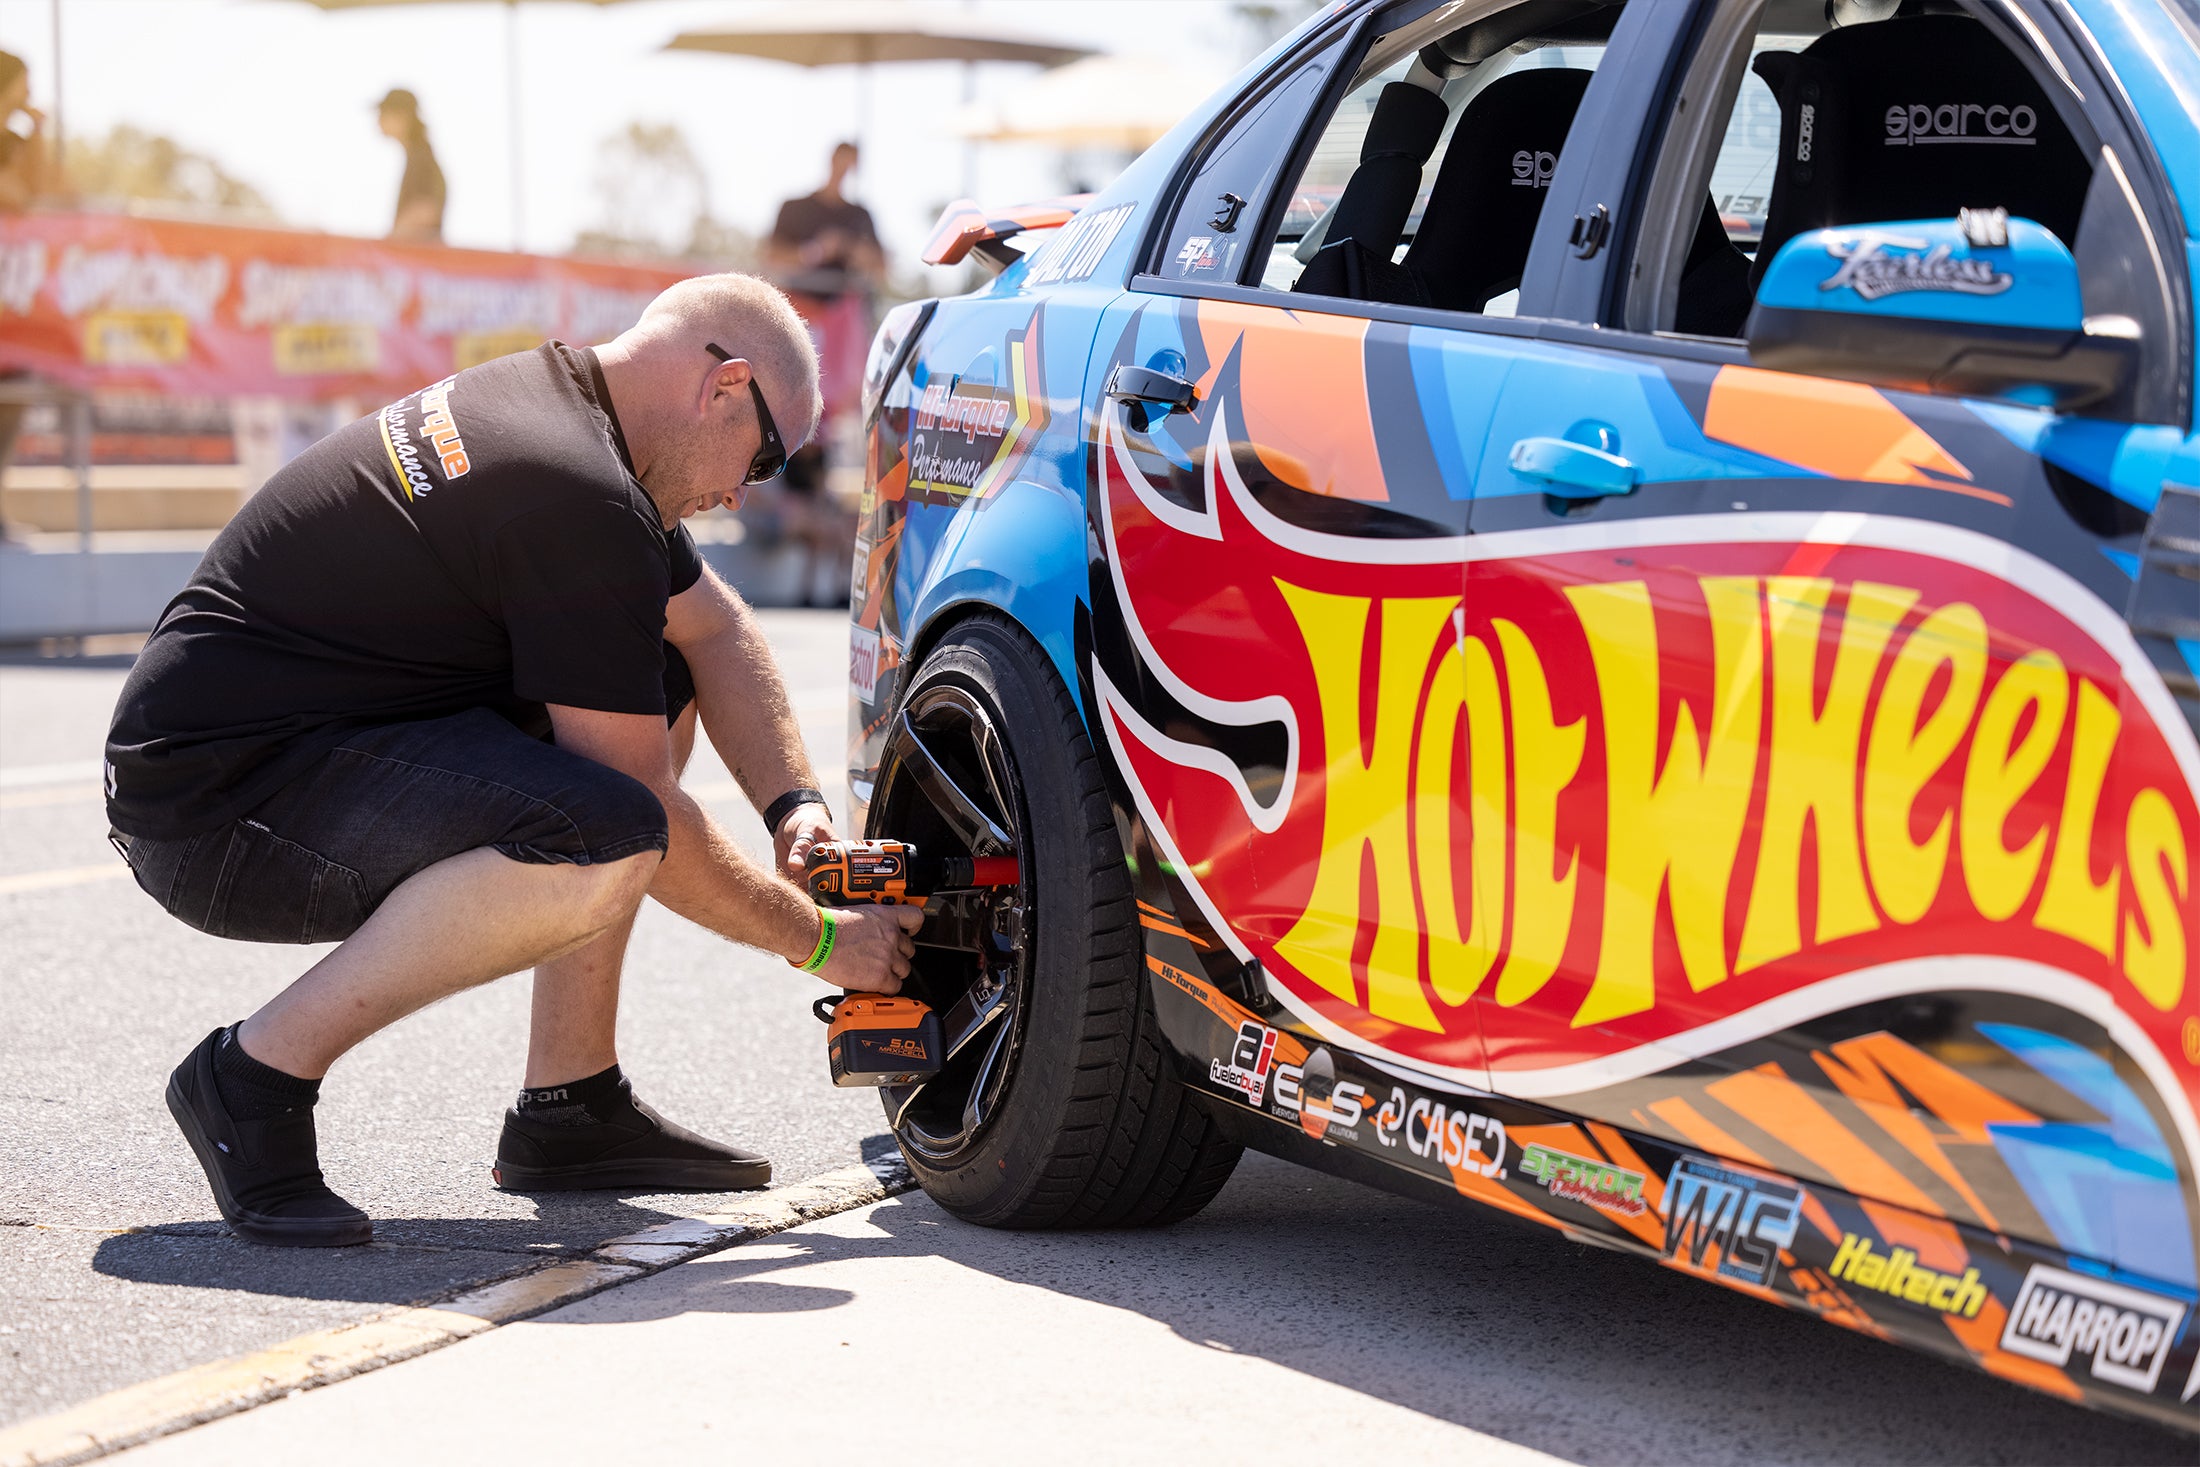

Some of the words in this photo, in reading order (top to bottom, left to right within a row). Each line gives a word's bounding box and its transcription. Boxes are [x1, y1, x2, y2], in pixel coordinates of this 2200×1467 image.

[1799, 104, 1815, 162] sparco
[1885, 104, 2037, 146] sparco
[910, 434, 981, 496] Performance
[1161, 965, 1208, 1002] Hi-Torque
[519, 1088, 568, 1108] p-on
[1210, 1064, 1264, 1095] fueledbyai
[1271, 1104, 1299, 1122] EVERYDAY
[1327, 1124, 1359, 1141] SOLUTIONS
[1829, 1233, 1988, 1318] Haltech
[2019, 1286, 2162, 1367] HARROP
